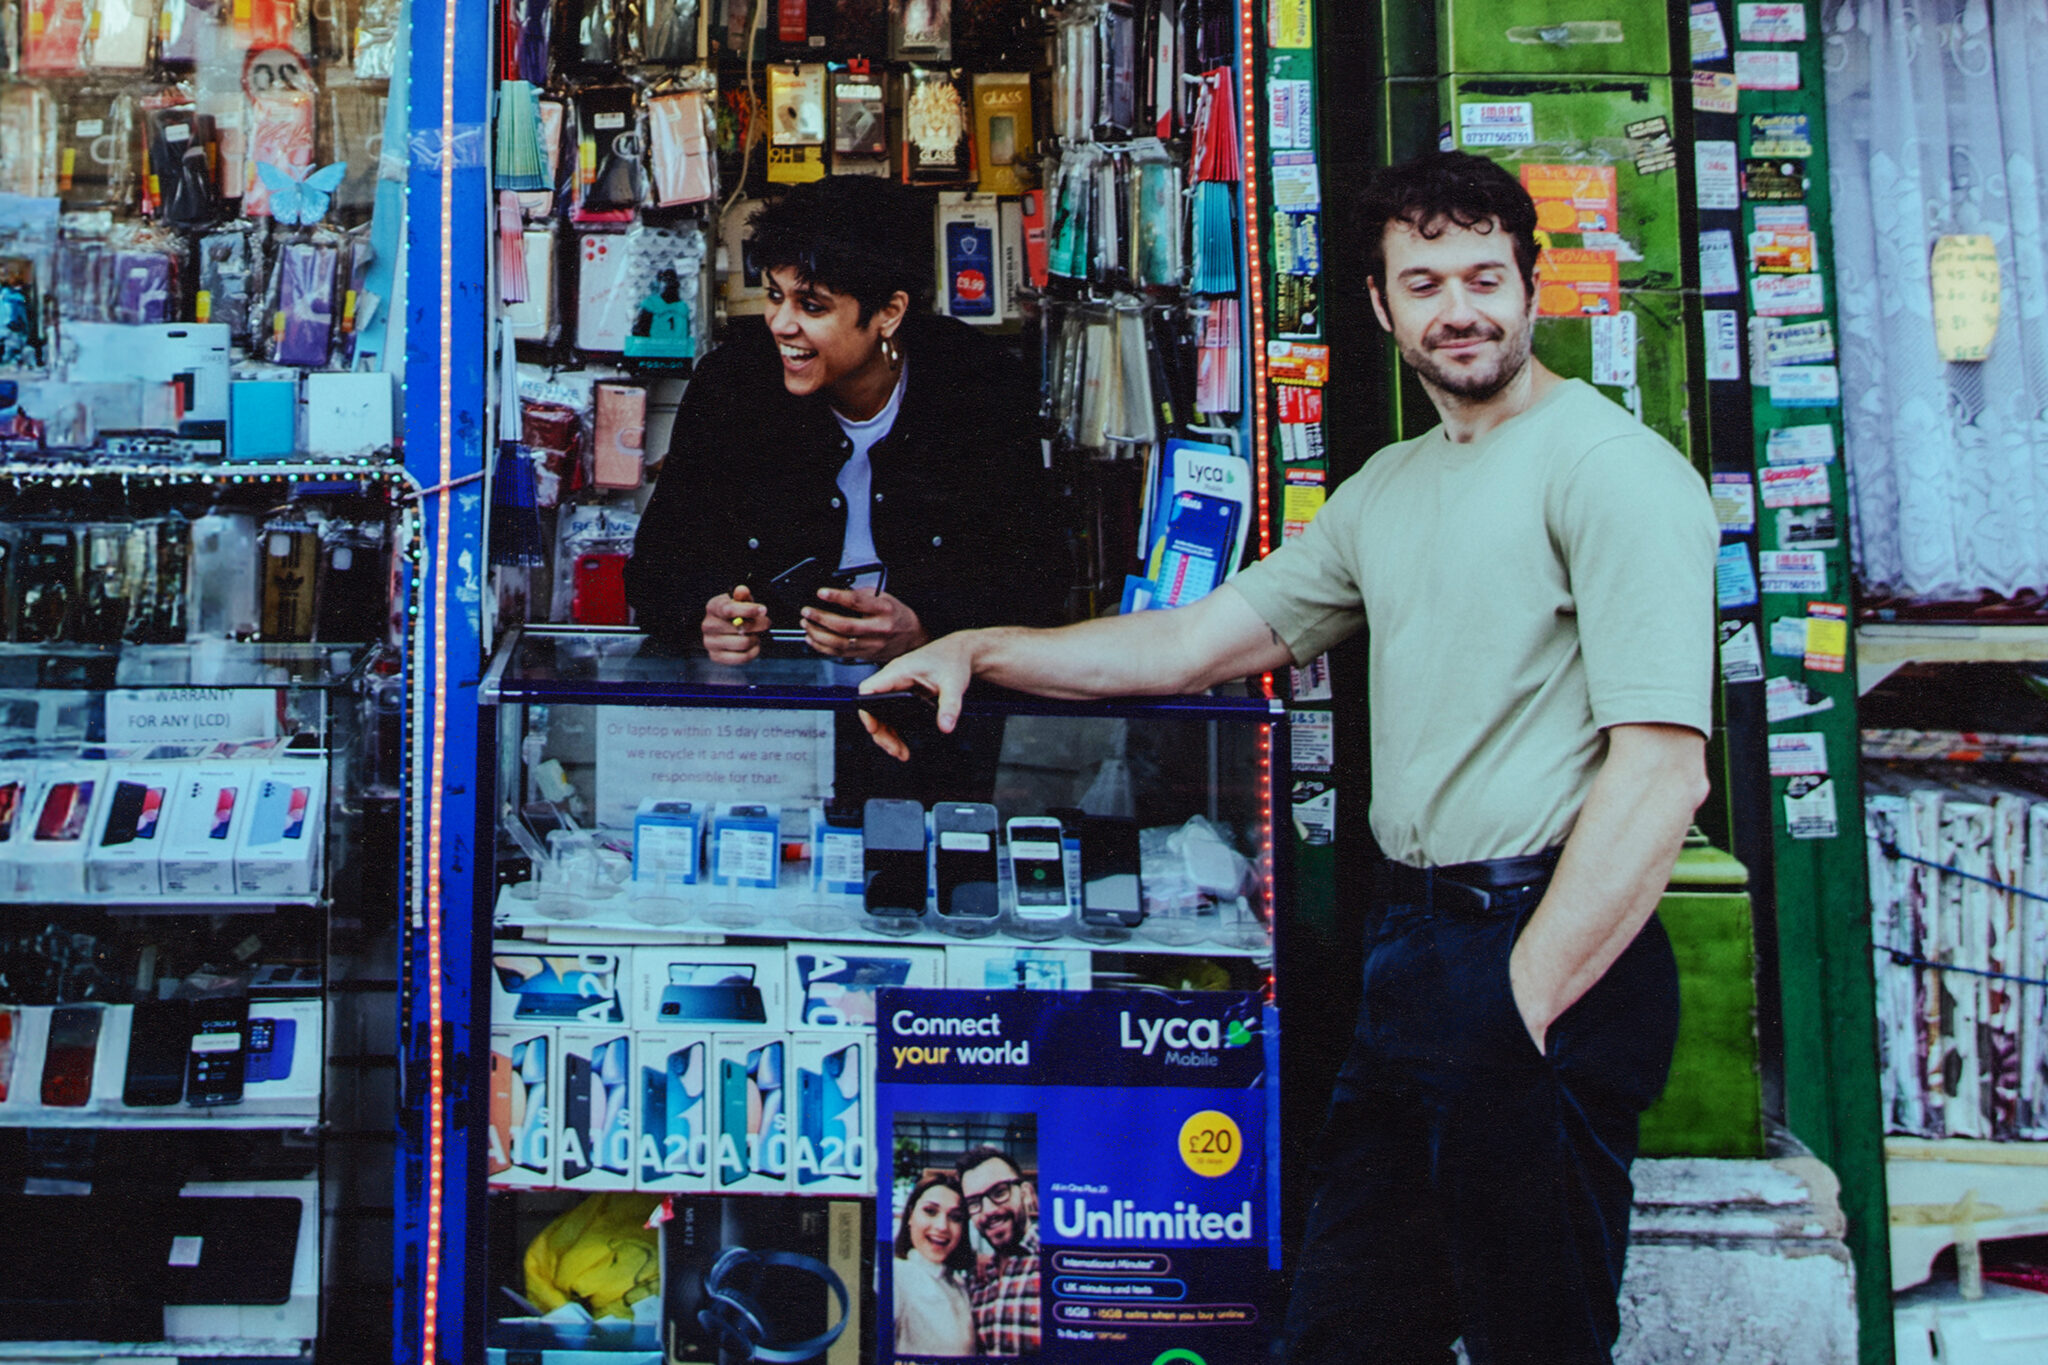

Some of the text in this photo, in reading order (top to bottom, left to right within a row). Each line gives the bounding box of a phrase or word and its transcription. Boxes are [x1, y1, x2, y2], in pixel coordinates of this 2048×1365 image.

[982, 90, 1023, 105] GLASS
[1480, 105, 1523, 118] SMART
[769, 148, 793, 164] 9H
[919, 149, 957, 165] GLASS
[1188, 460, 1223, 483] Lyca
[128, 712, 231, 730] FOR ANY (LCD)
[606, 722, 828, 741] Or laptop within 15 day otherwise
[626, 746, 808, 762] we recycle it and we are not
[651, 770, 726, 785] responsible
[729, 771, 747, 784] for
[891, 1010, 1002, 1037] Connect
[1119, 1011, 1221, 1056] Lyca
[892, 1040, 1030, 1069] your world
[1164, 1049, 1219, 1067] Mobile
[1188, 1129, 1233, 1155] £20
[640, 1133, 708, 1174] A20
[795, 1136, 866, 1176] A20
[1053, 1197, 1253, 1240] Unlimited
[1063, 1257, 1116, 1270] International
[1063, 1281, 1154, 1295] UK minutes and texts
[1124, 1310, 1149, 1320] extra
[1150, 1310, 1177, 1320] when
[1178, 1312, 1196, 1321] you
[1197, 1310, 1214, 1321] buy
